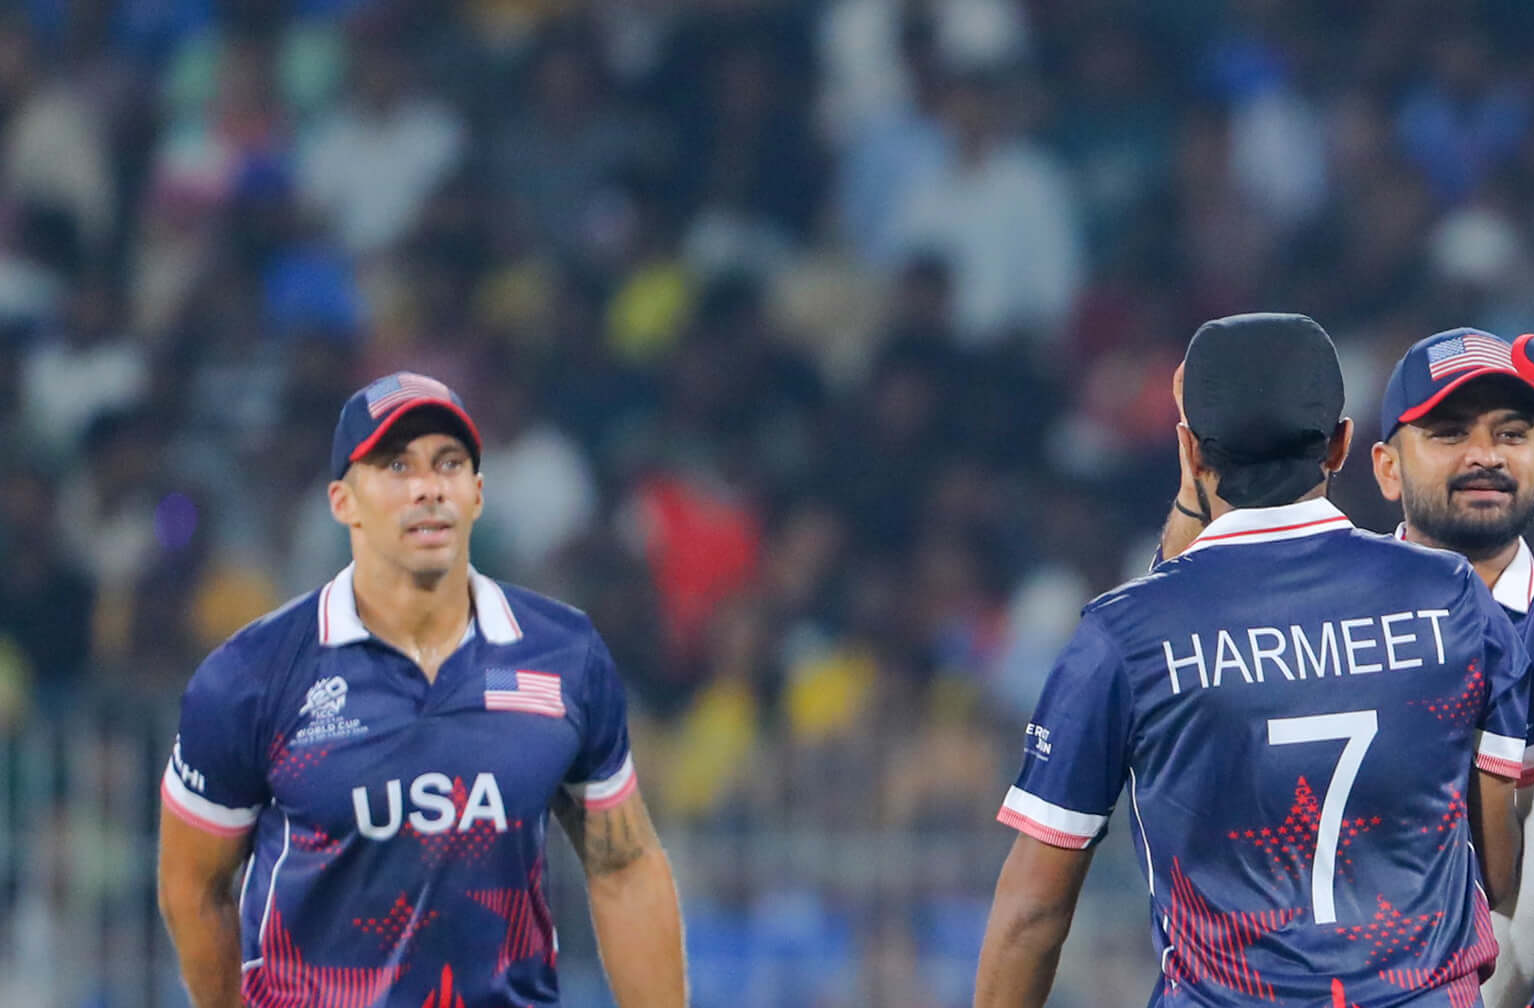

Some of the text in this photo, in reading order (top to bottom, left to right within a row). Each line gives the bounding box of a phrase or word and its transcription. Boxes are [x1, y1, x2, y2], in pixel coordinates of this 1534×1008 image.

[1162, 609, 1450, 694] HARMEET
[352, 771, 508, 842] USA
[1267, 709, 1379, 925] 7
